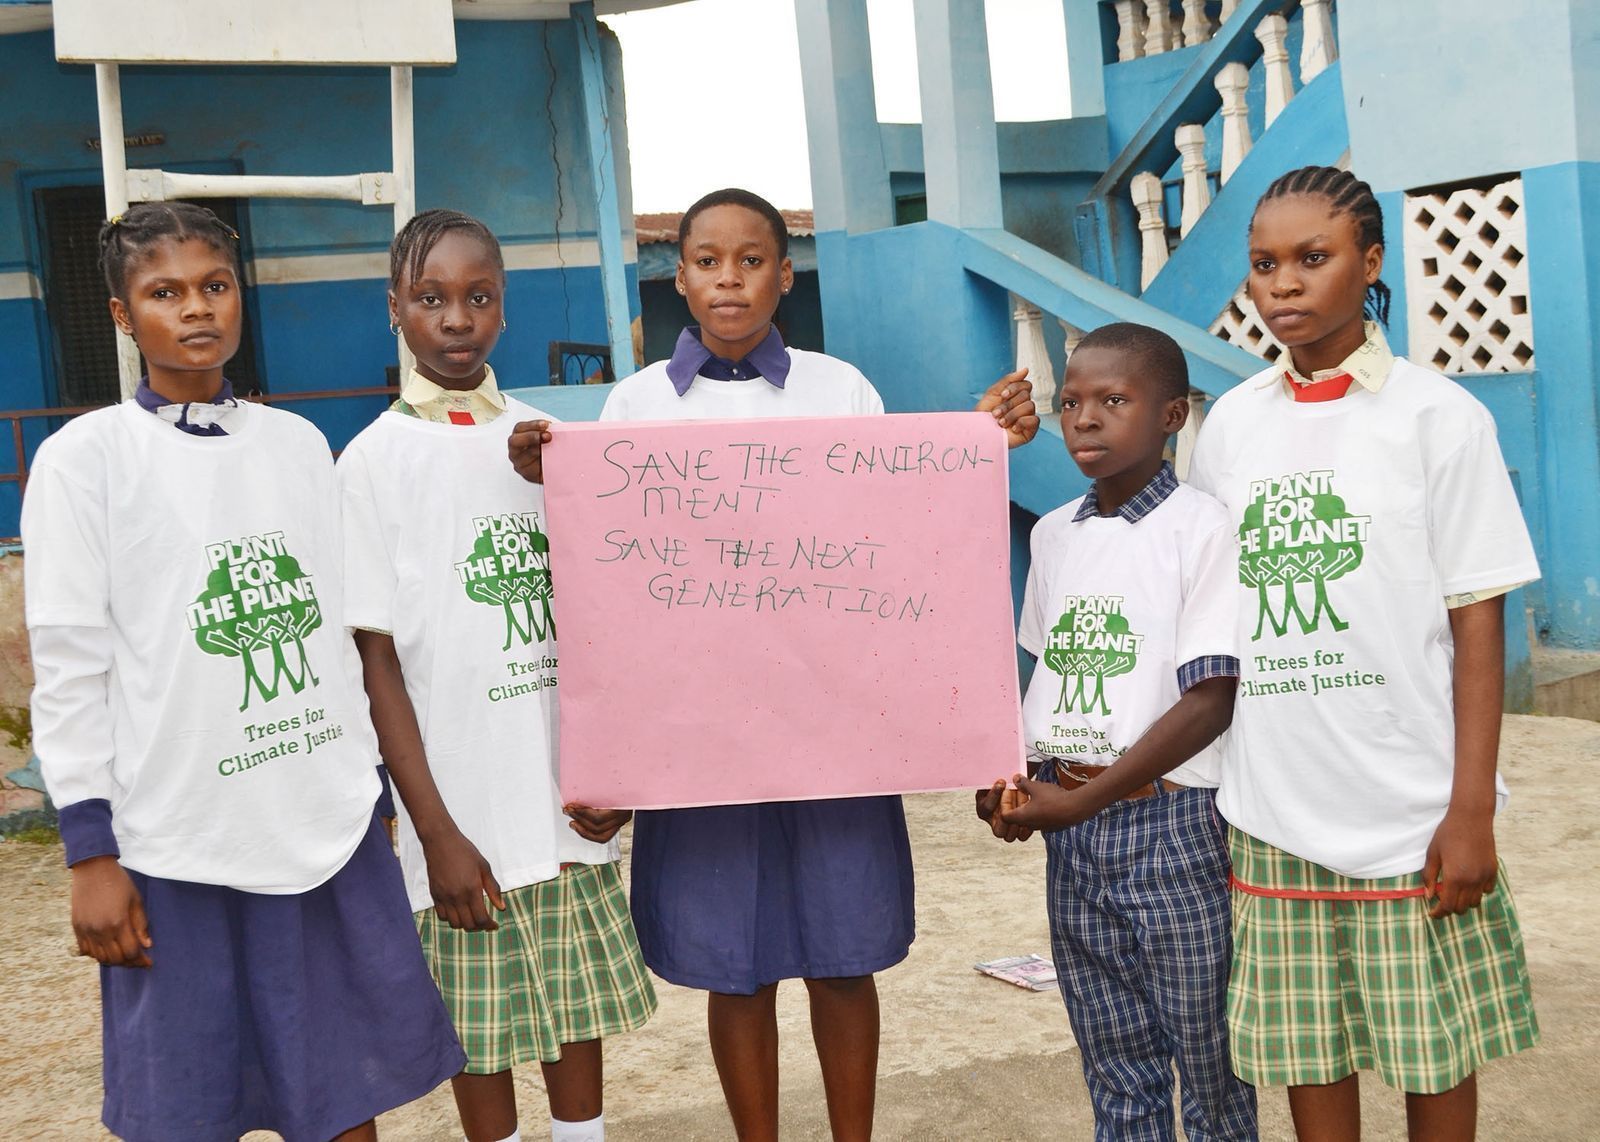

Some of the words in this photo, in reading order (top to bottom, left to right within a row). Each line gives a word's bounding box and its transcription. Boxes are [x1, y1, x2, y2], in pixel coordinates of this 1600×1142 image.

[596, 440, 720, 498] SAVE
[826, 440, 993, 476] ENVIRON-
[644, 485, 781, 519] MENT
[1250, 470, 1334, 505] PLANT
[472, 511, 540, 538] PLANT
[1263, 497, 1316, 527] FOR
[205, 530, 288, 570] PLANT
[491, 532, 534, 556] FOR
[595, 529, 690, 567] SAVE
[705, 538, 780, 570] THE
[790, 536, 886, 570] NEXT
[1236, 527, 1261, 555] HE
[1268, 515, 1372, 550] PLANET
[228, 560, 280, 591] FOR
[454, 556, 498, 584] THE
[501, 551, 550, 575] PLAN
[186, 594, 237, 631] THE
[1065, 595, 1124, 615] PLANT
[1073, 614, 1107, 633] FOR
[1073, 632, 1145, 655] PLANET
[541, 655, 559, 669] for
[1254, 655, 1308, 672] Trees
[1314, 650, 1344, 667] for
[1311, 670, 1386, 695] Justice
[244, 716, 301, 743] Trees
[305, 708, 325, 725] for
[1052, 725, 1089, 737] Trees
[1090, 726, 1106, 740] or
[218, 741, 299, 776] Climate
[1035, 741, 1087, 754] Climate
